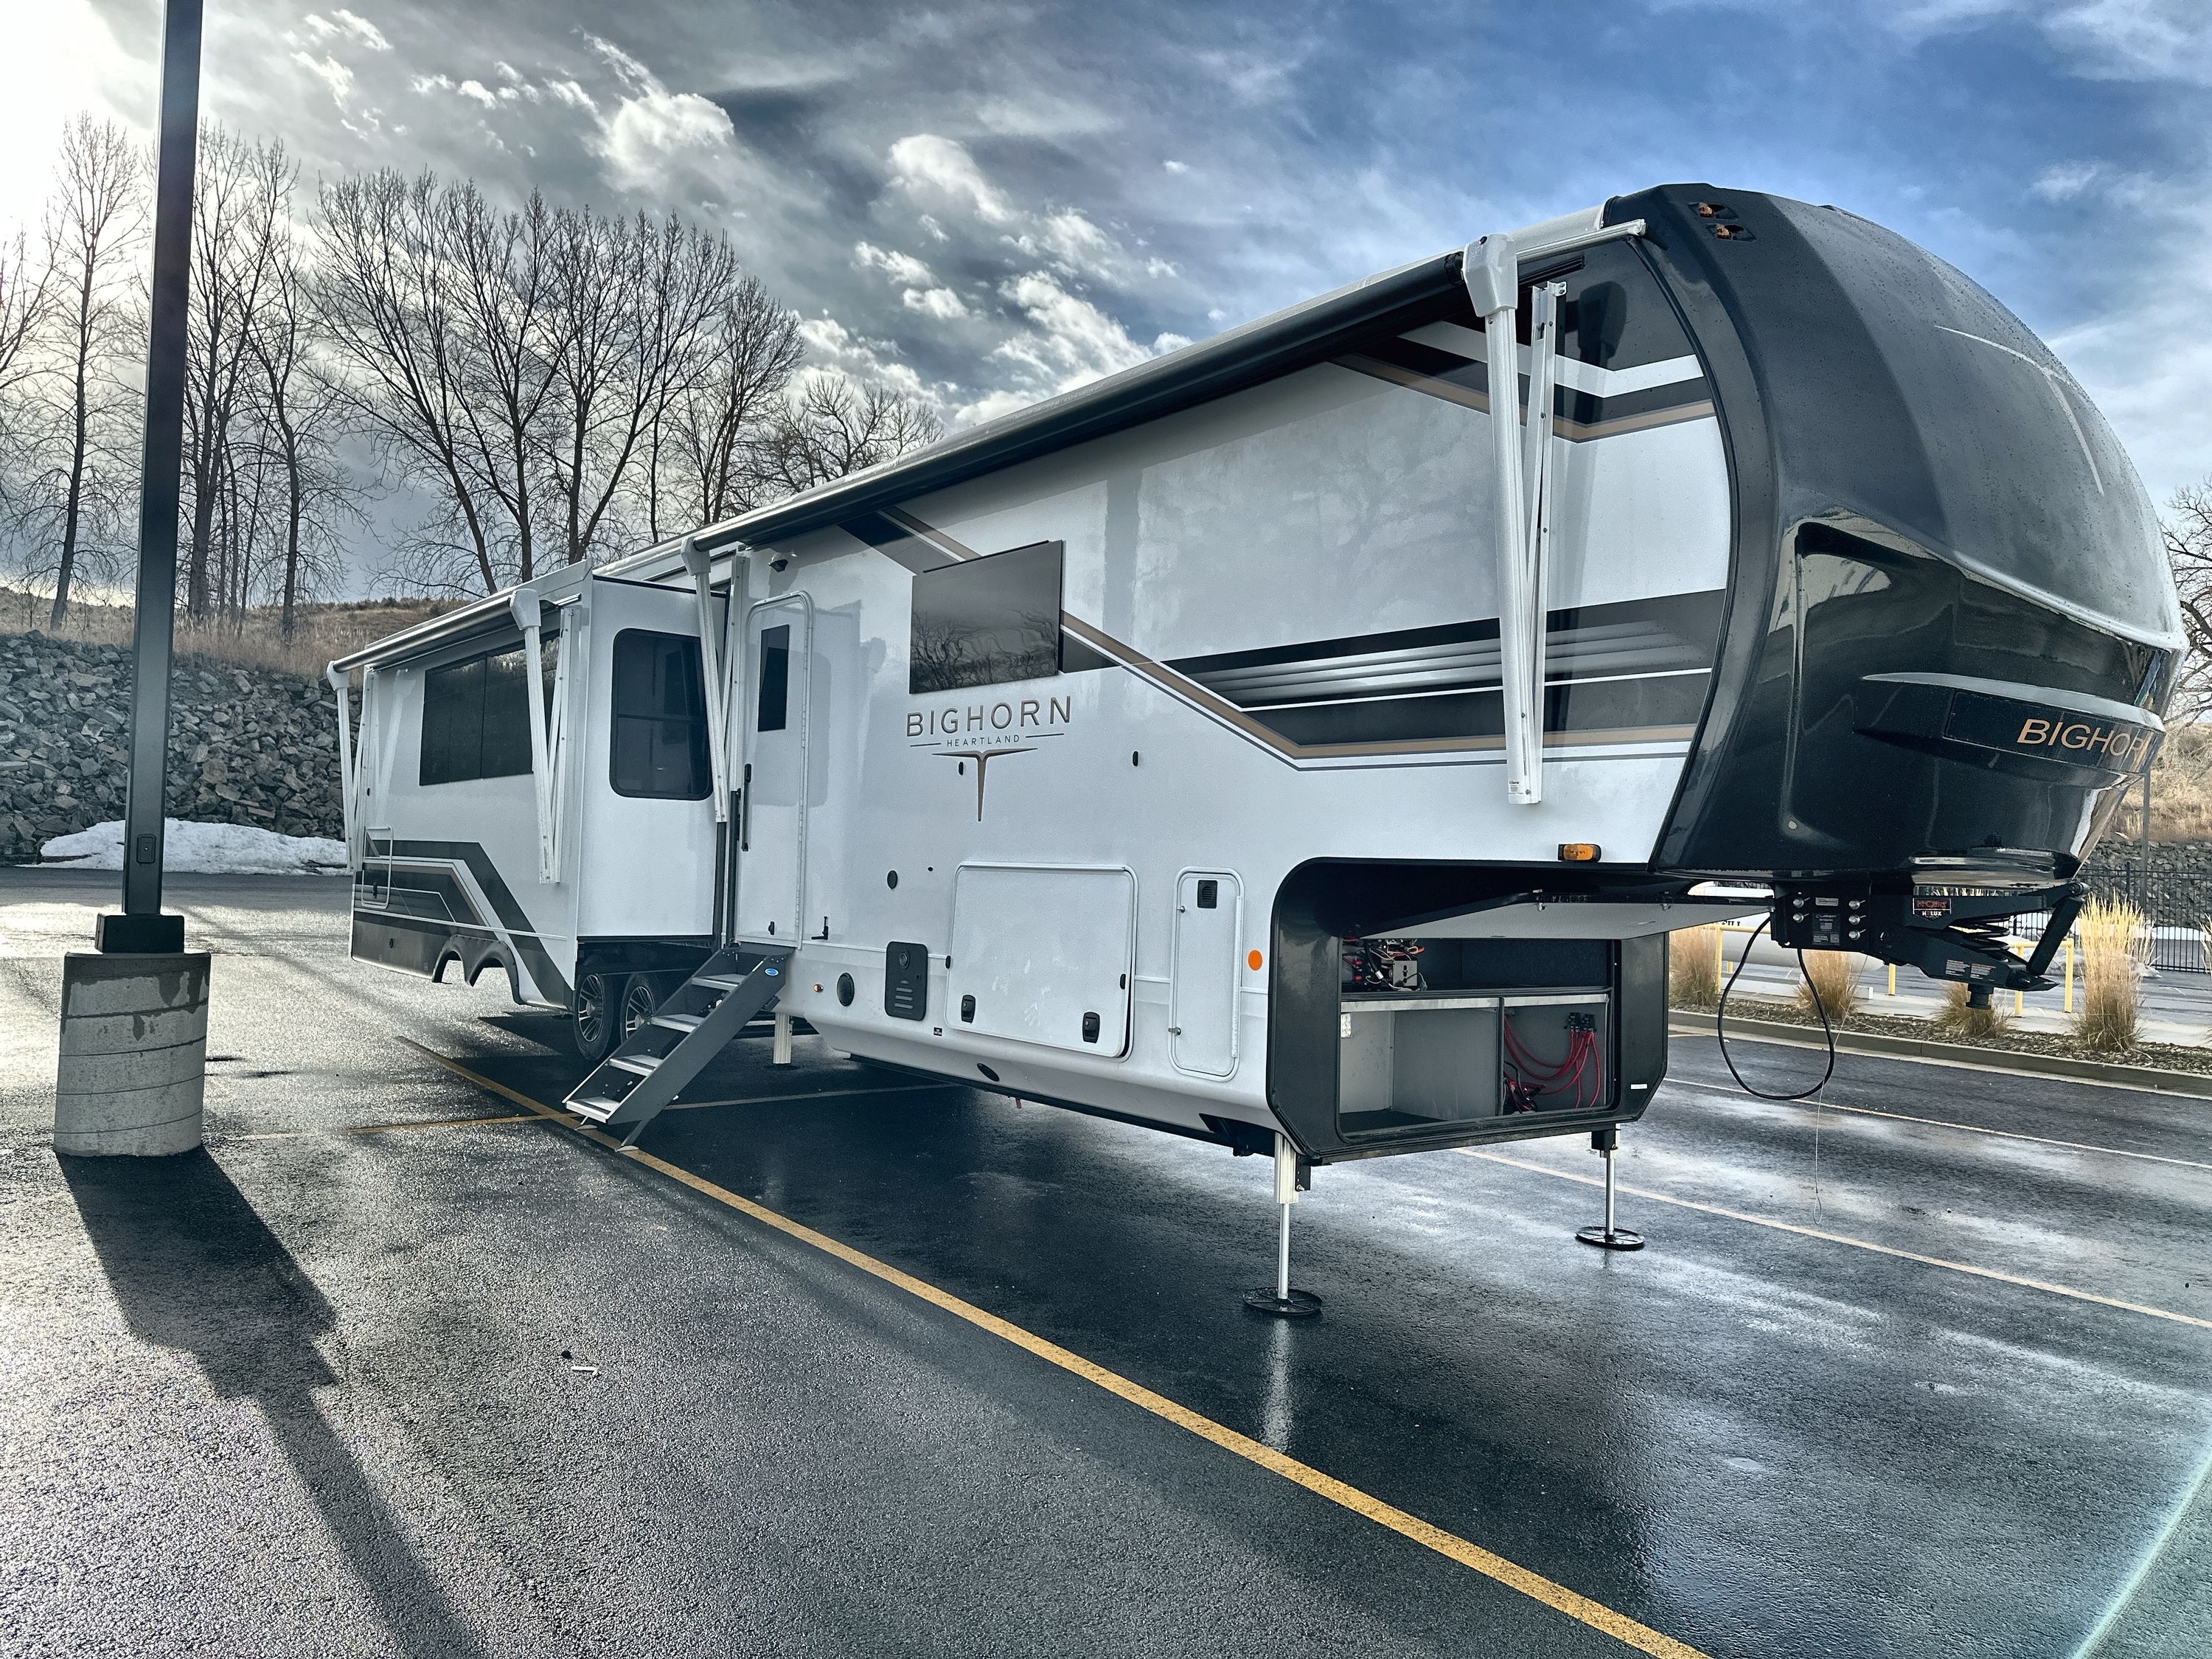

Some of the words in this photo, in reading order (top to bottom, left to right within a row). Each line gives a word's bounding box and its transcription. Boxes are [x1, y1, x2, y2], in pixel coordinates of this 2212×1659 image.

[906, 695, 1071, 737] BIGHORN
[947, 734, 1020, 747] HEARTLAND
[2017, 718, 2146, 763] BIGHOR
